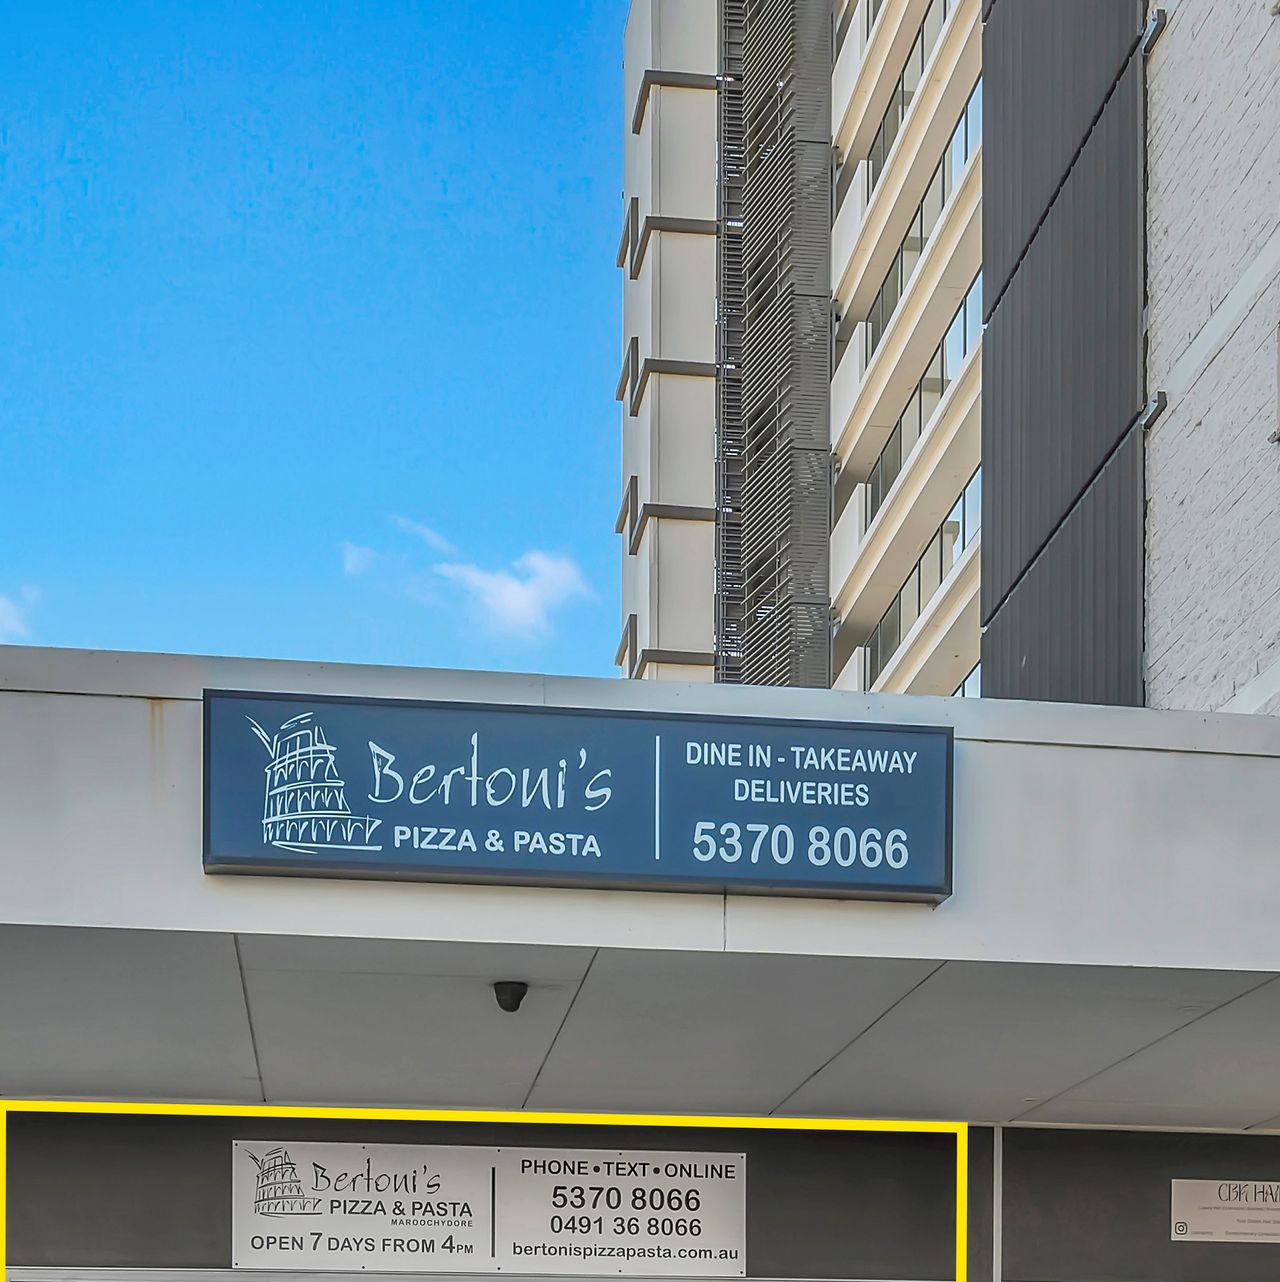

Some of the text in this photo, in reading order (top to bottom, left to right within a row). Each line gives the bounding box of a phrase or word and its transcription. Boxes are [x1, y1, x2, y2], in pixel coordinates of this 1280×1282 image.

[686, 741, 742, 768] DINE
[748, 744, 773, 768] IN
[790, 745, 918, 774] TAKEAWAY
[368, 732, 613, 811] Bertoni's
[733, 778, 870, 806] DELIVERIES
[393, 825, 602, 858] PIZZA & PASTA
[691, 820, 910, 869] 5370 8066
[311, 1157, 441, 1194] Bertoni's
[521, 1159, 736, 1179] PHONE TEXT ONLINE
[551, 1185, 701, 1212] 5370 8066
[1217, 1183, 1249, 1202] CBK
[329, 1199, 473, 1218] PIZZA & PASTA
[391, 1218, 473, 1228] MAROOCHYDORE
[550, 1215, 702, 1237] 0491 36 8066
[250, 1232, 474, 1254] OPEN 7 DAYS FROM 4PM
[512, 1242, 739, 1261] bertonispizzapasta.com.au
